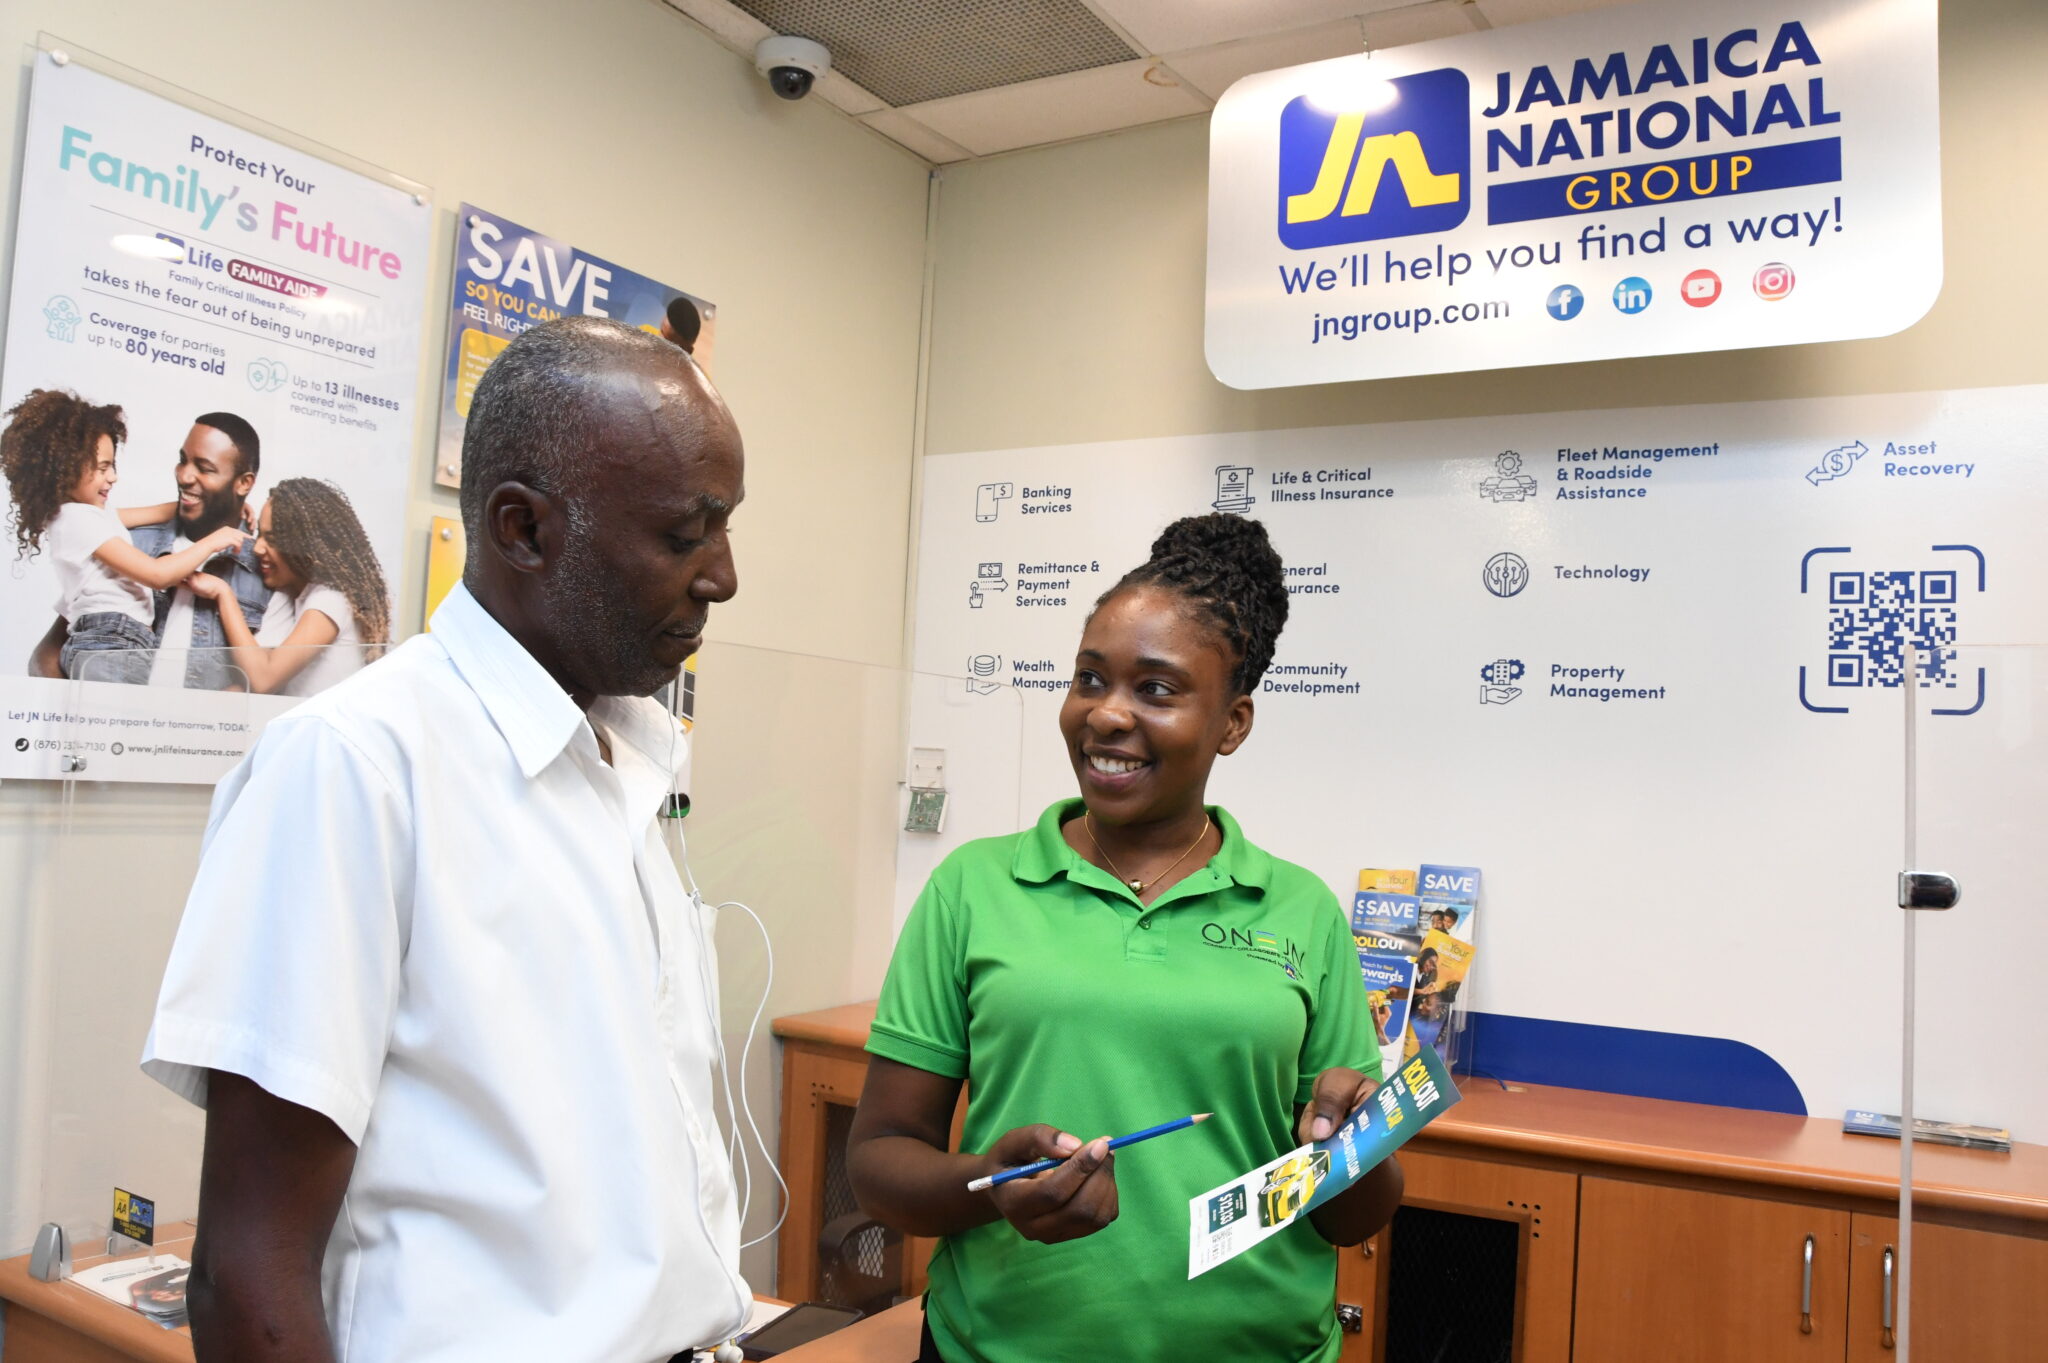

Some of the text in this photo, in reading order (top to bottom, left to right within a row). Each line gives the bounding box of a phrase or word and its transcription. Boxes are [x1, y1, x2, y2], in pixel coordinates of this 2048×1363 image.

[1482, 21, 1822, 120] JAMAICA
[1487, 77, 1842, 174] NATIONAL
[190, 134, 316, 195] Protect Your
[1566, 155, 1754, 212] GROUP
[271, 200, 402, 281] Future
[1384, 245, 1472, 285] help
[1485, 238, 1562, 277] you
[1578, 217, 1667, 263] find
[1684, 221, 1712, 249] a
[1727, 197, 1844, 247] way!
[188, 246, 225, 273] Life
[231, 262, 284, 290] FAMILY
[284, 279, 318, 299] AIDE
[467, 220, 612, 318] SAVE
[168, 270, 205, 290] Family
[206, 280, 244, 300] Critical
[246, 292, 277, 310] Illness
[279, 302, 307, 320] Policy
[465, 281, 561, 321] SO YOU CAN
[84, 265, 377, 360] takes the fear out of being unprepared
[463, 301, 492, 325] FEEL
[1312, 298, 1511, 345] jngroup.com
[89, 312, 226, 358] Coverage for parties
[88, 332, 226, 377] up to 80 years old
[291, 391, 358, 414] covered with
[293, 375, 400, 411] Up to 13 illnesses
[1556, 442, 1720, 464] Fleet Management
[1883, 440, 1937, 457] Asset
[1272, 467, 1371, 485] Life & Critical
[1557, 463, 1653, 481] & Roadside
[1884, 459, 1976, 479] Recovery
[1022, 485, 1072, 499] Banking
[1271, 488, 1394, 502] Illness Insurance
[1556, 484, 1648, 501] Assistance
[1021, 502, 1072, 514] Services
[1018, 560, 1100, 574] Remittance &
[1281, 562, 1327, 577] eneral
[1554, 563, 1651, 583] Technology
[1017, 578, 1071, 593] Payment
[1015, 594, 1067, 607] Services
[1013, 659, 1055, 672] Wealth
[1550, 663, 1626, 682] Property
[1012, 676, 1073, 692] Managem
[1263, 679, 1361, 697] Development
[1549, 682, 1667, 702] Management
[8, 710, 25, 720] Let
[26, 711, 40, 723] JN
[43, 712, 62, 722] Life
[88, 717, 107, 726] you
[109, 717, 150, 728] prepare
[152, 718, 166, 728] for
[168, 720, 216, 732] tomorrow,
[34, 739, 61, 751] (876)
[1424, 873, 1473, 893] SAVE
[1366, 899, 1415, 919] SAVE
[1361, 967, 1404, 984] ewards
[1401, 1057, 1440, 1112] ROLLOUT
